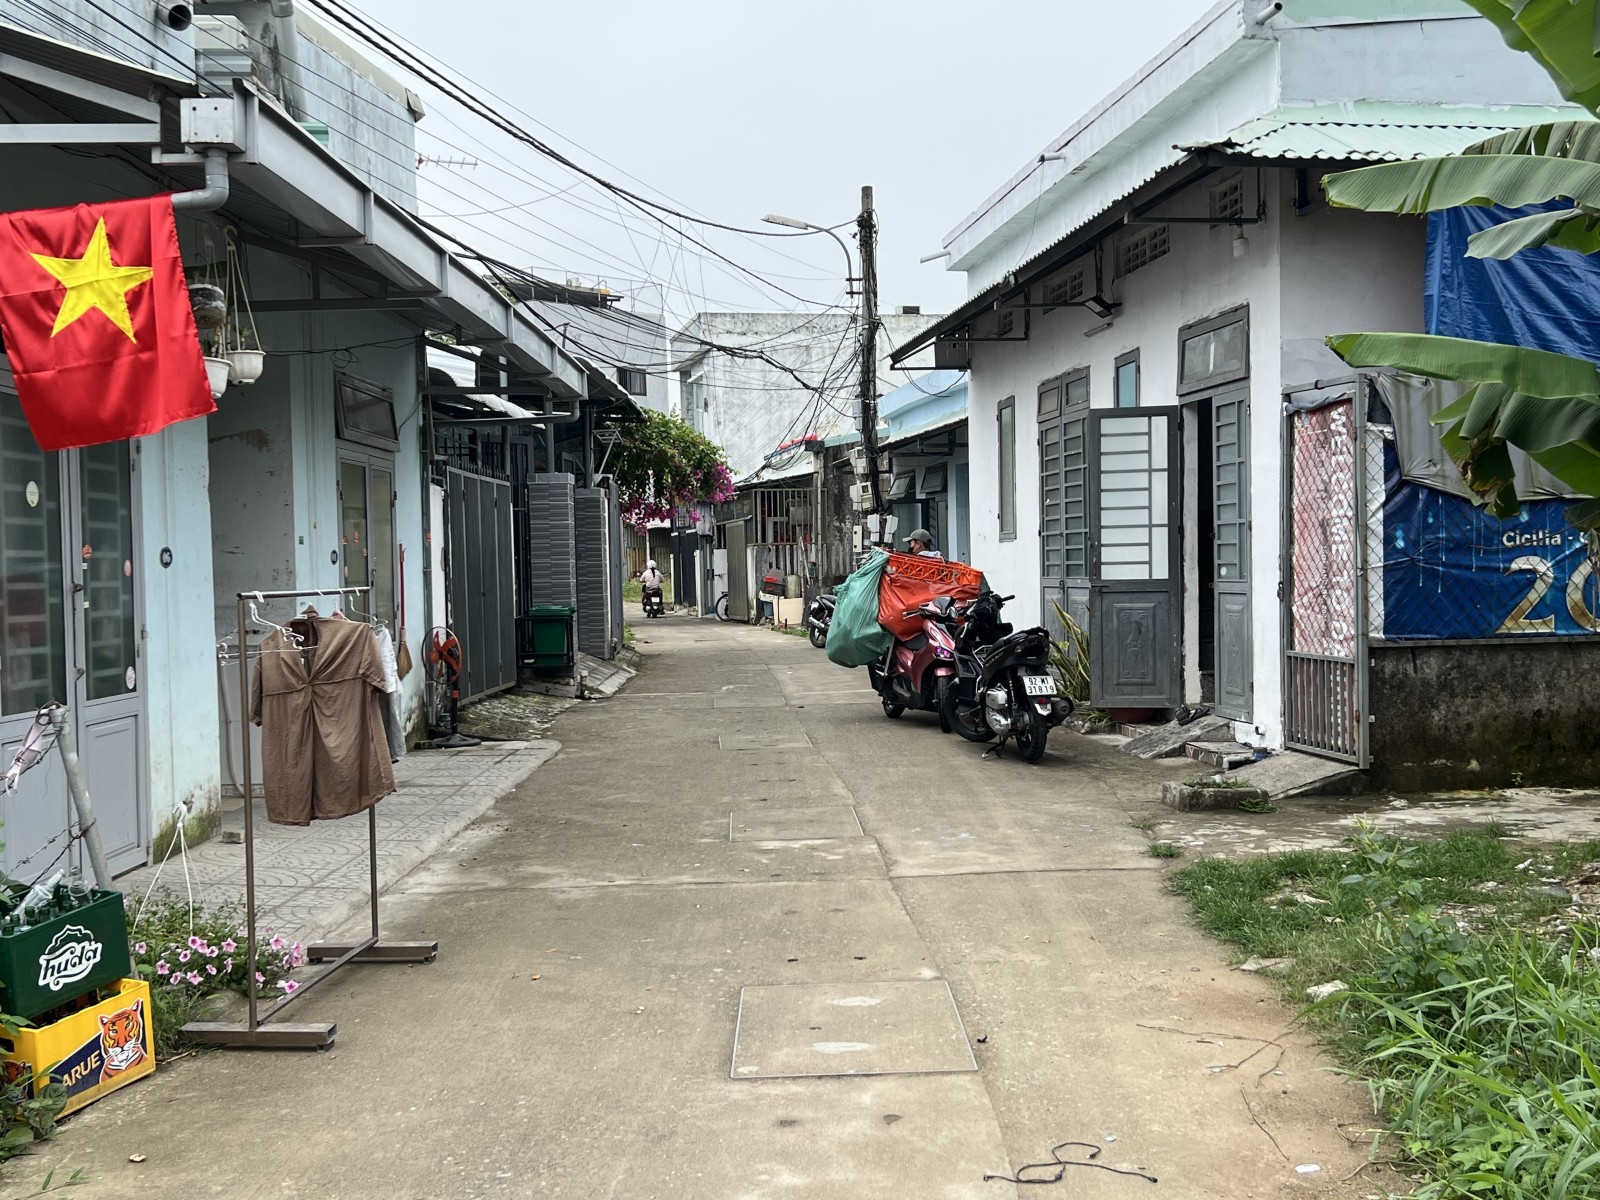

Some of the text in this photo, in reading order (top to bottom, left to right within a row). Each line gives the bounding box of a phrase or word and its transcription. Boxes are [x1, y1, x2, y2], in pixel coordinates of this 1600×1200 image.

[1331, 405, 1348, 561] WELCOME
[1502, 529, 1561, 547] Cicilia
[1331, 569, 1348, 611] TO
